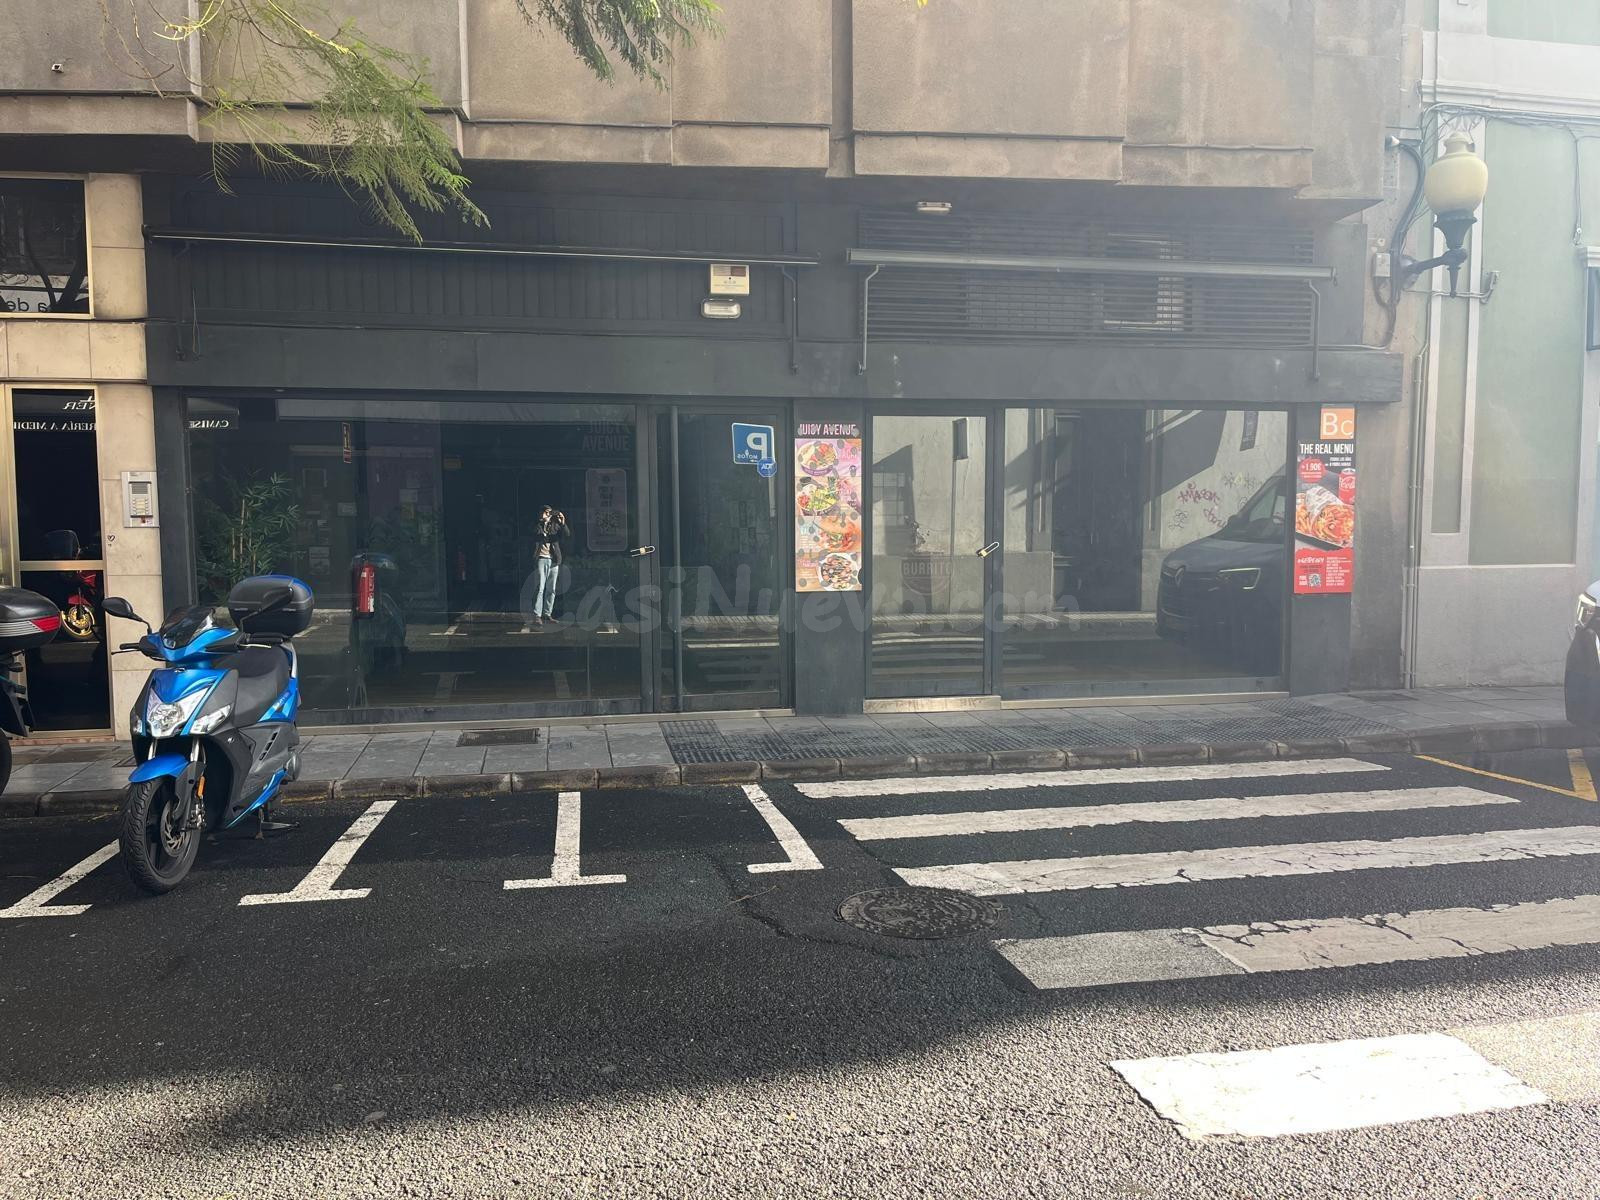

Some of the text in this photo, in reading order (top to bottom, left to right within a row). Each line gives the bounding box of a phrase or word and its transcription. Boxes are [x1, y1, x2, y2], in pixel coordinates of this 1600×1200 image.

[1299, 443, 1354, 455] THE REAL MENU
